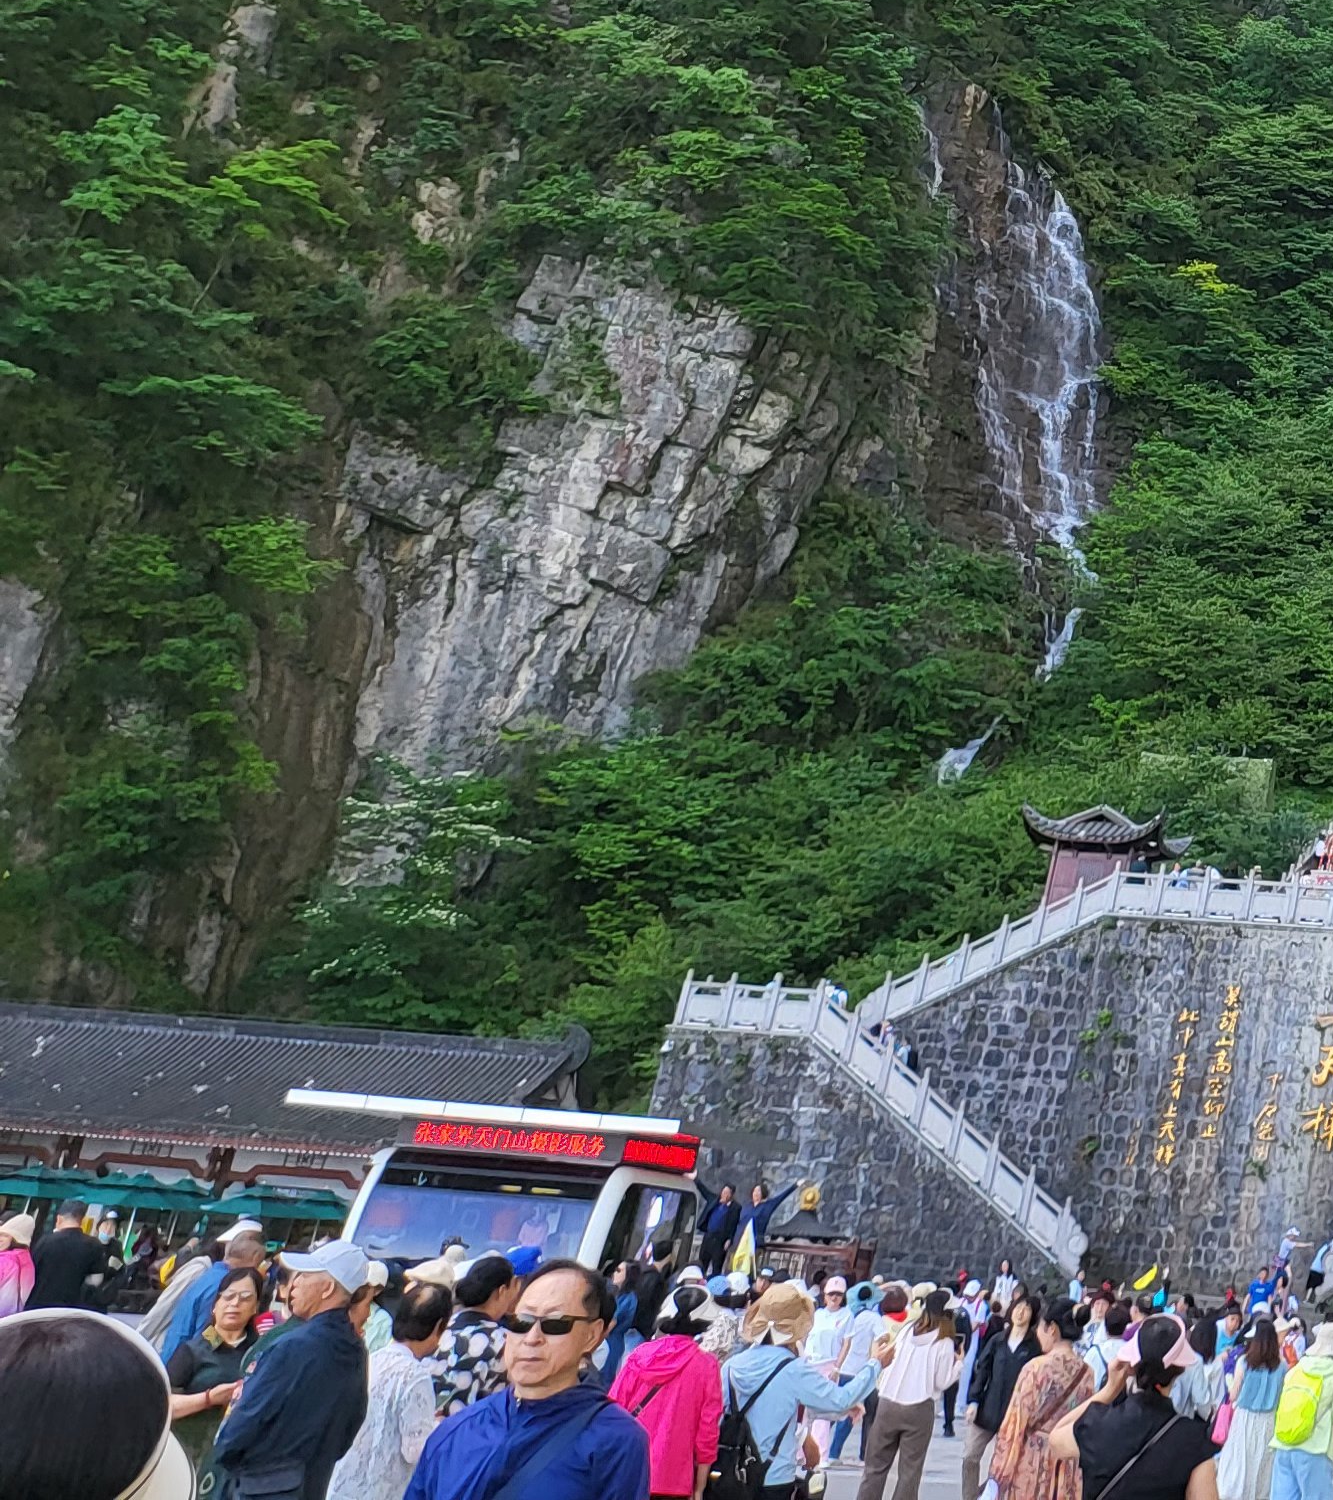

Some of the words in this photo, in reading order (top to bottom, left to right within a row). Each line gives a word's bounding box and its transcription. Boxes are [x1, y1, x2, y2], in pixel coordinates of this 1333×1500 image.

[415, 1122, 606, 1158] 张家界天门山摄影服务
